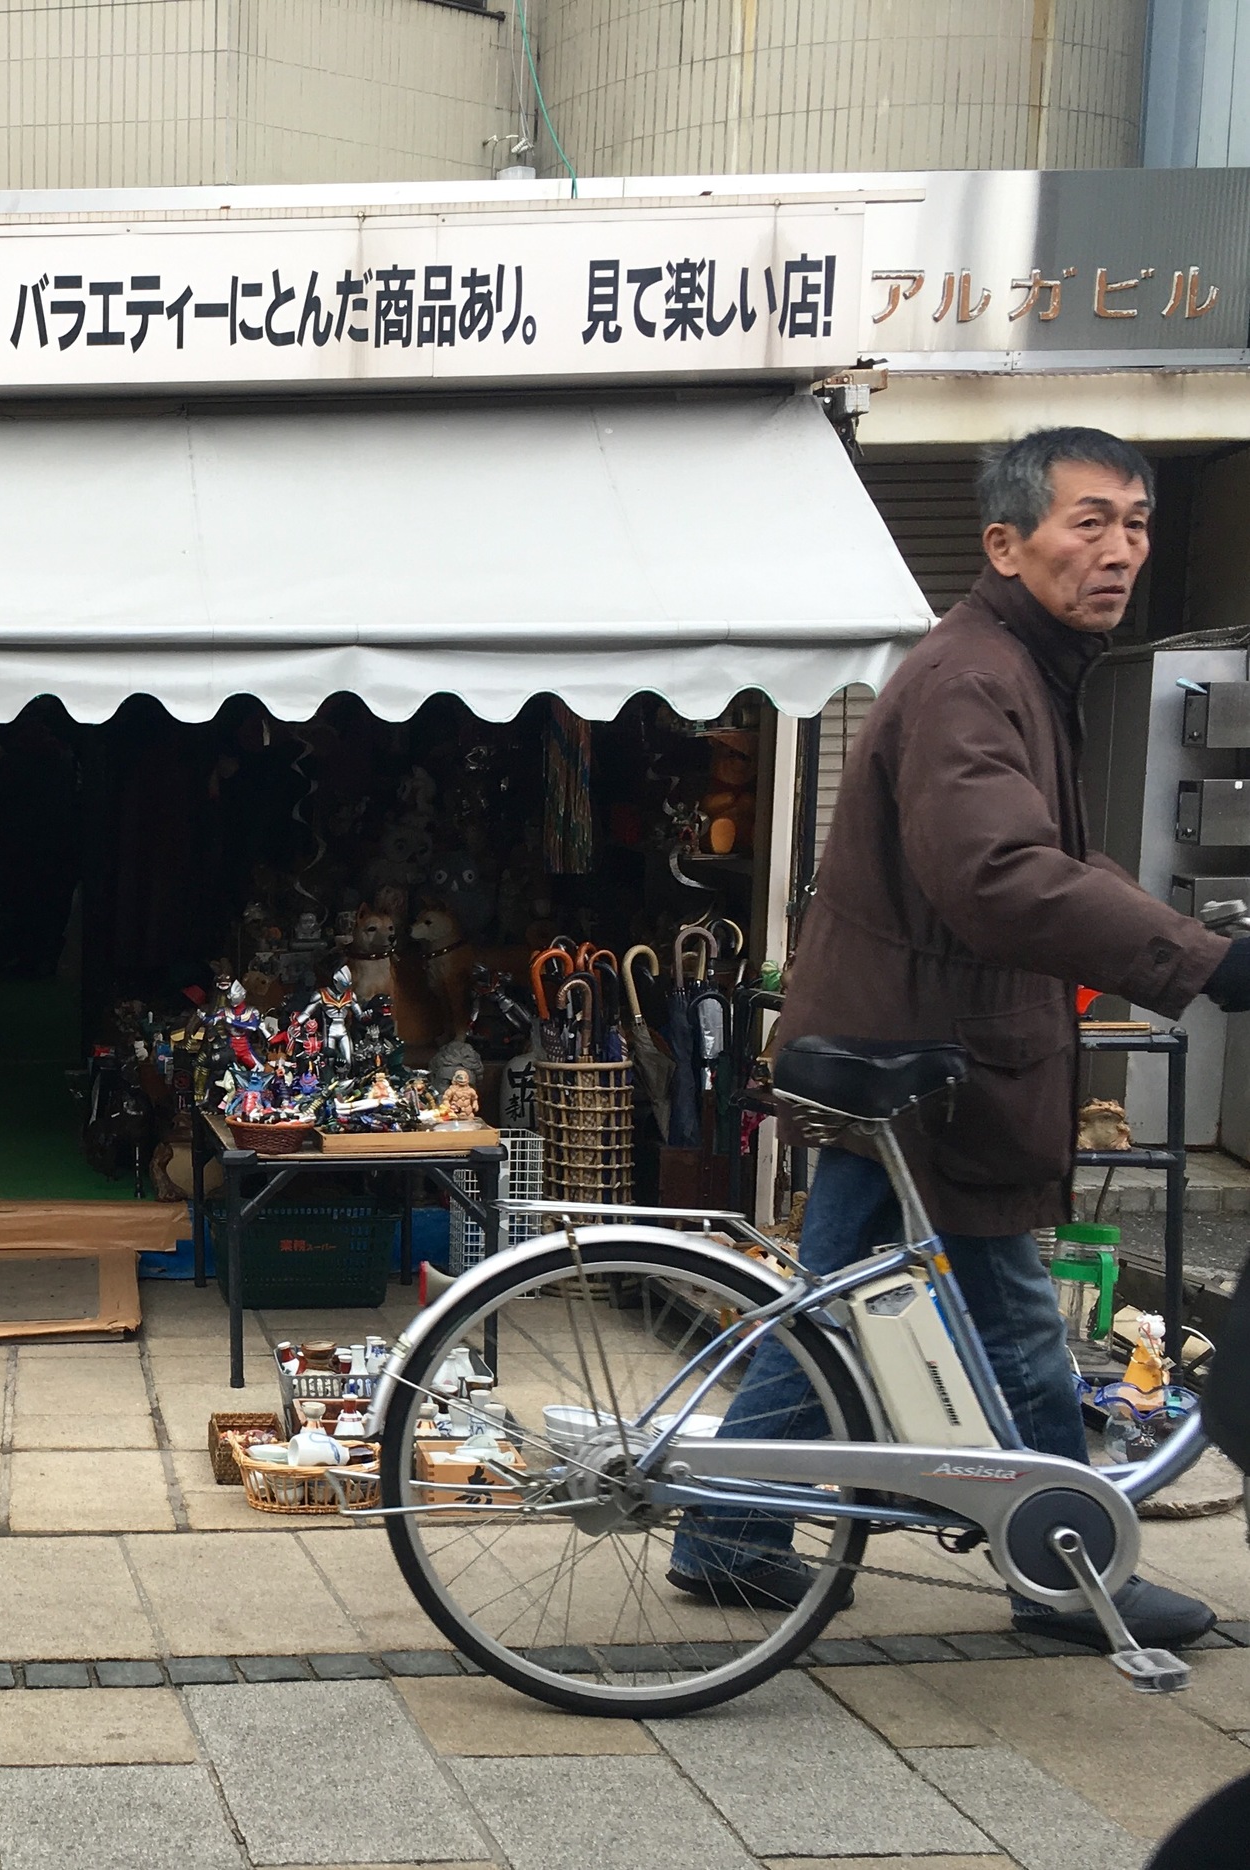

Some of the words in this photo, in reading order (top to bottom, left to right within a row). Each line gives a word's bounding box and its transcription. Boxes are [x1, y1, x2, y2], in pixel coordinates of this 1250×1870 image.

[10, 263, 537, 353] バラエティーにとんだ商品あり。
[871, 265, 1220, 324] アルガビル
[931, 1462, 1017, 1480] Assista
